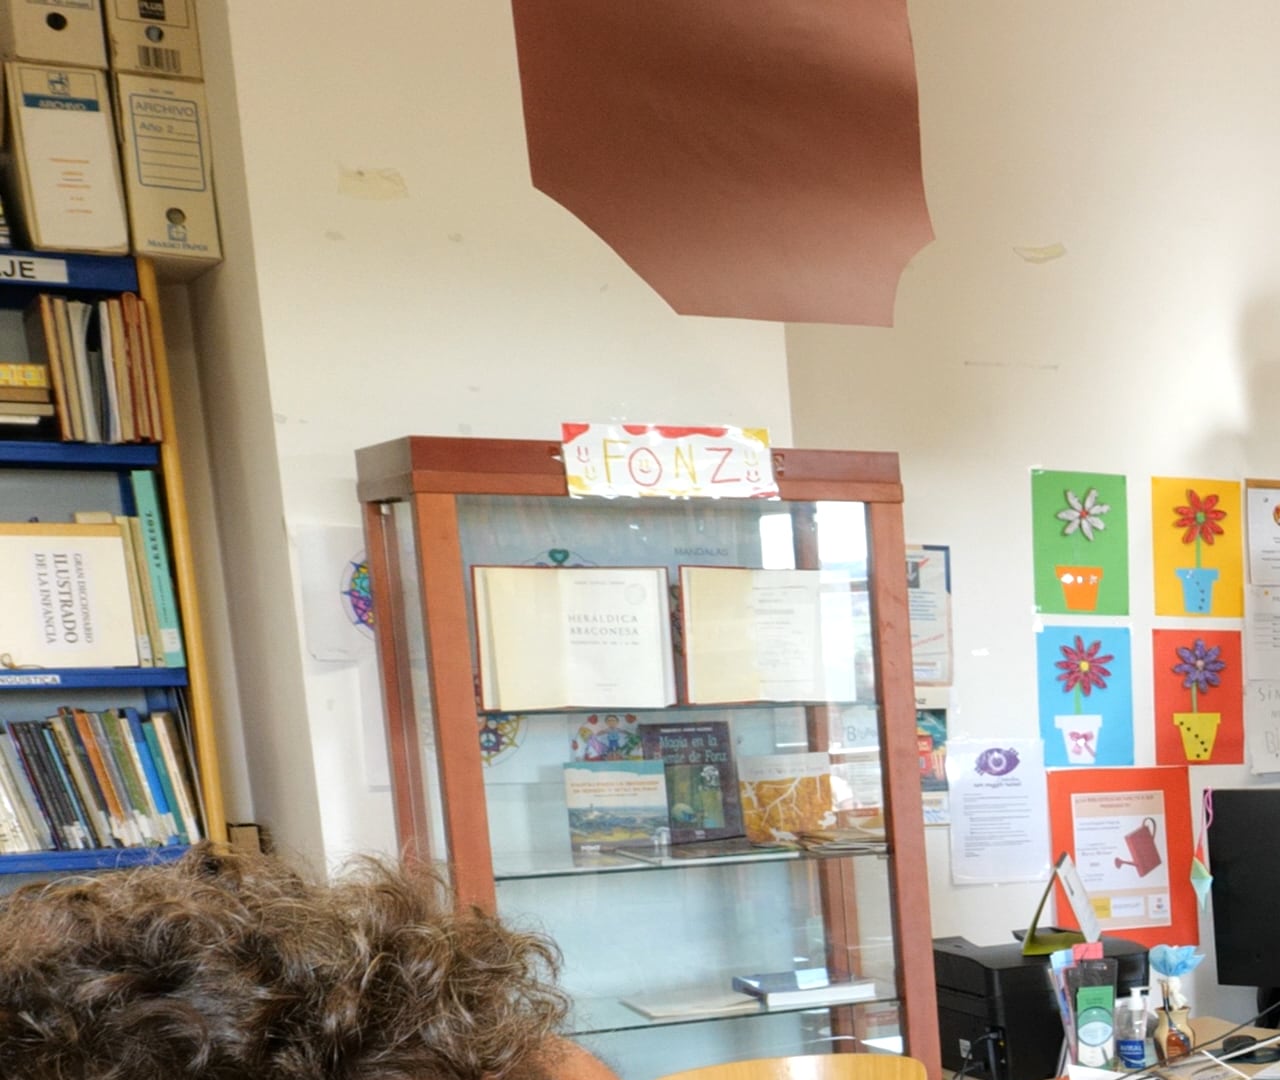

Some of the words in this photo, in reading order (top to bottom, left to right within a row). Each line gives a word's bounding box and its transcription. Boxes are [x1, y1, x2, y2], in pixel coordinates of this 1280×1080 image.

[135, 101, 194, 116] ARCHIVO
[0, 261, 36, 279] JE
[603, 438, 741, 487] FONZ
[53, 553, 79, 644] ILUSTRADO
